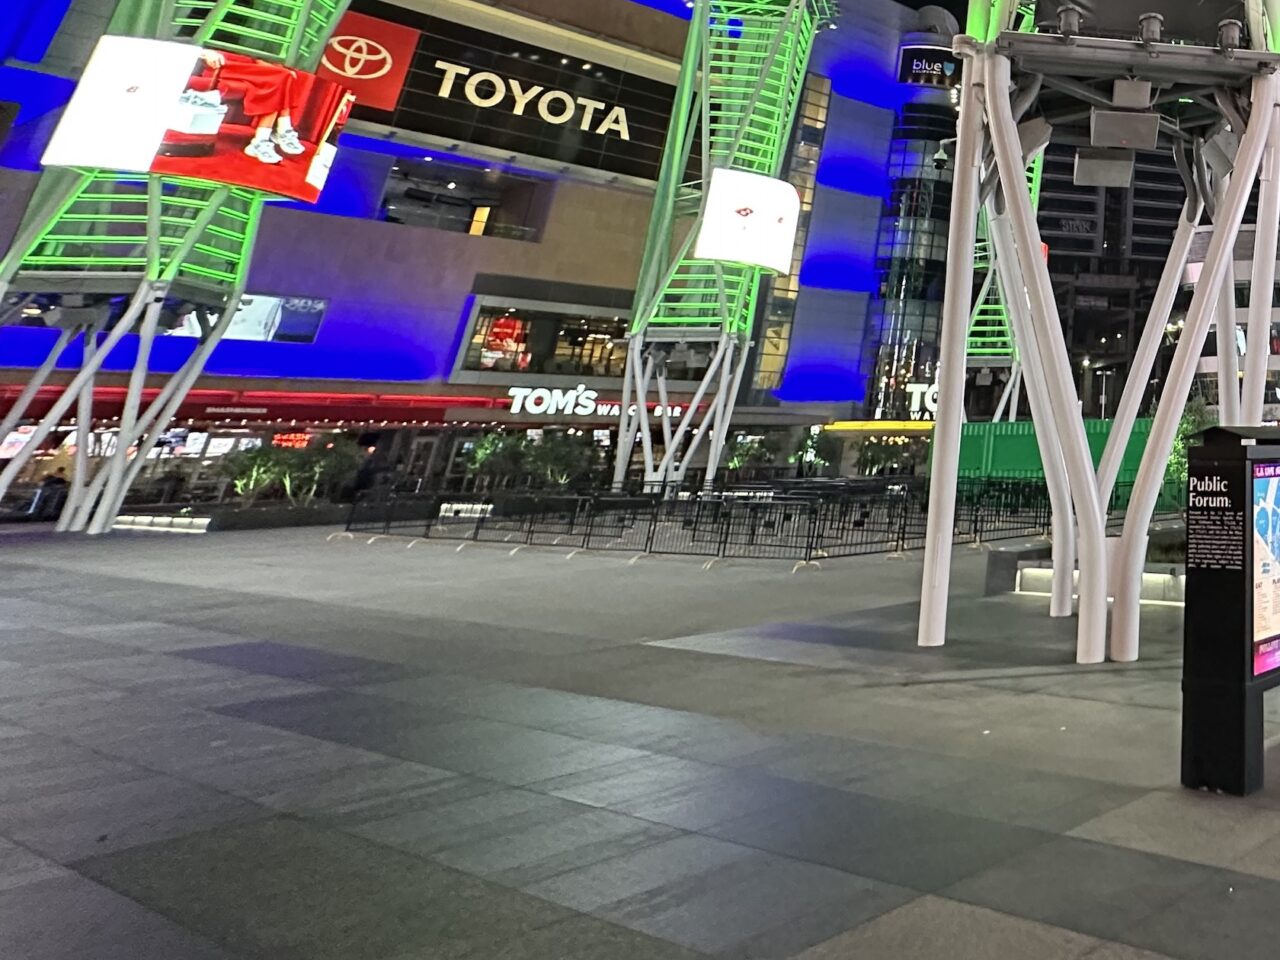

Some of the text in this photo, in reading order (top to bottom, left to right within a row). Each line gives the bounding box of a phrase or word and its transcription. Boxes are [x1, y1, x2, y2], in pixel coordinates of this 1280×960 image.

[912, 58, 942, 72] blue
[434, 60, 631, 141] TOYOTA
[508, 384, 598, 416] TOM'S
[1189, 476, 1229, 492] Public
